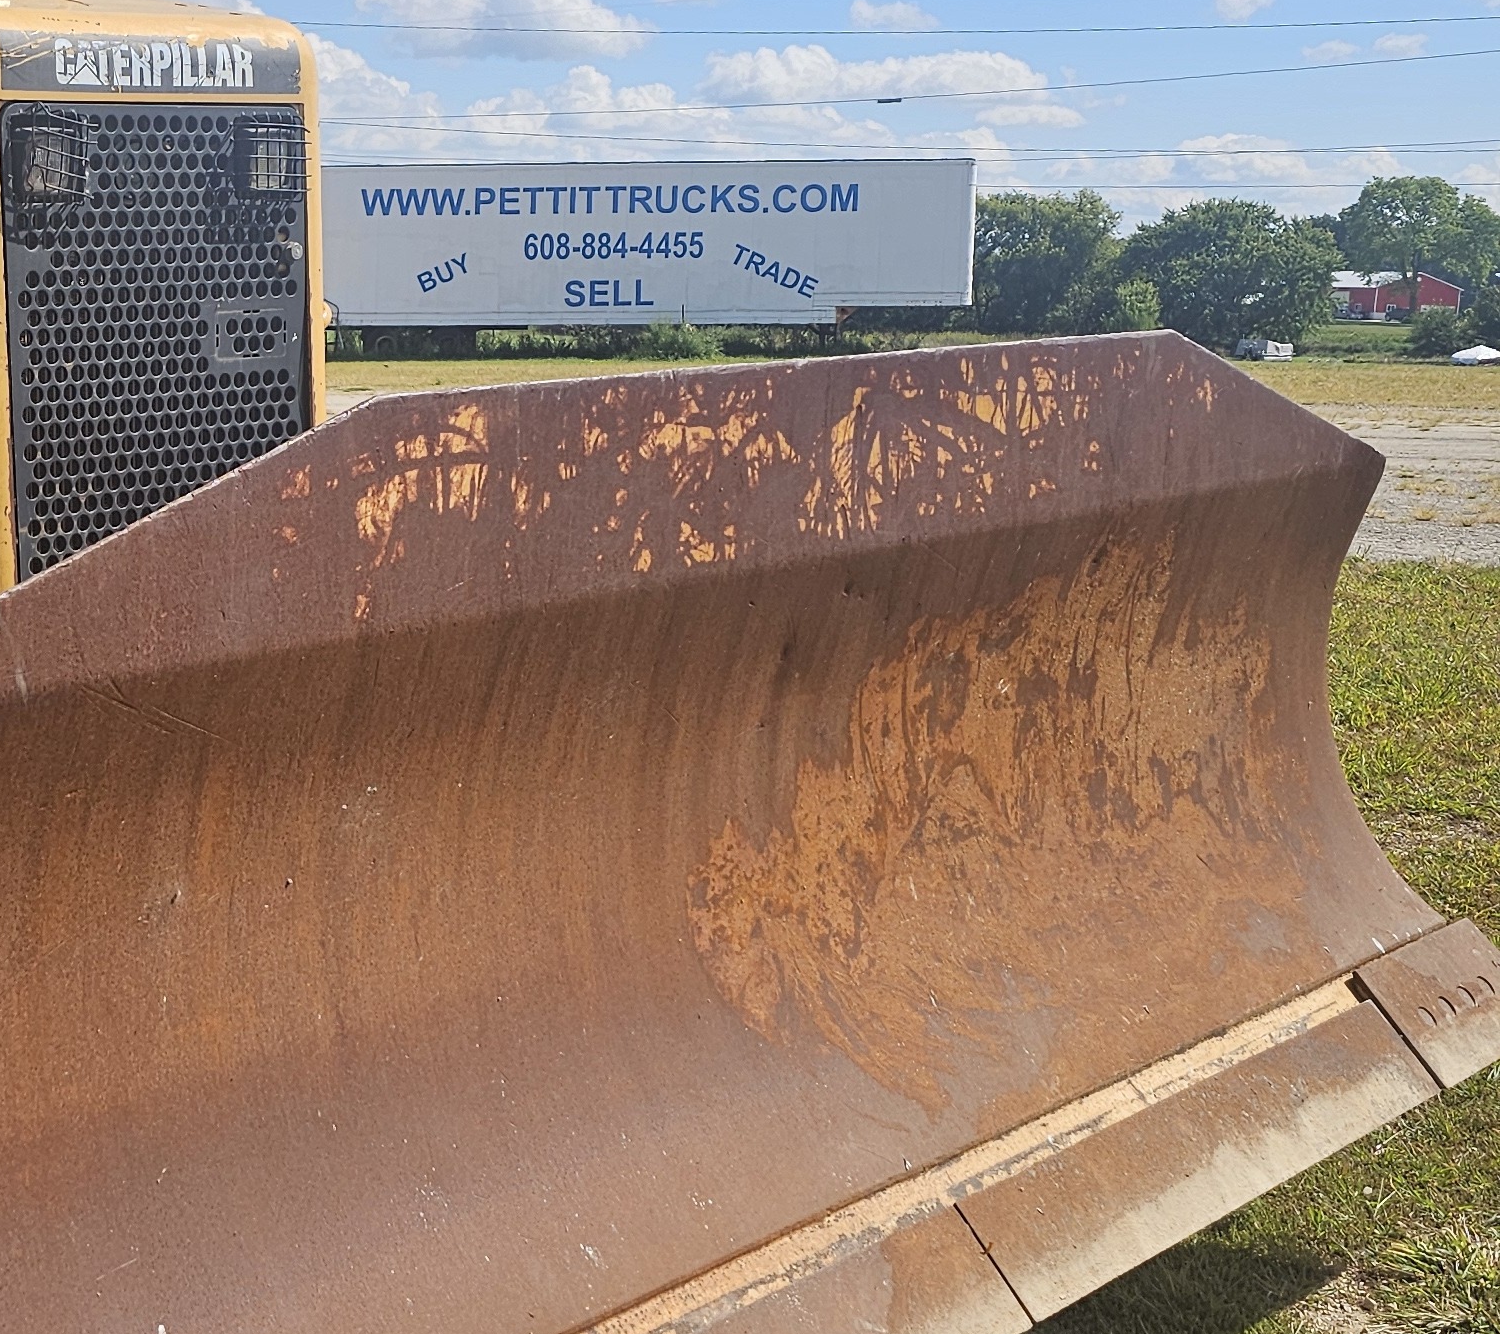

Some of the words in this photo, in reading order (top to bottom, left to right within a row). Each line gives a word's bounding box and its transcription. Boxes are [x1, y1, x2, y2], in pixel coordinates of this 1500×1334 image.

[54, 37, 254, 88] CATERPILLAR
[360, 183, 859, 216] WWW.PETTITTRUCKS.COM
[523, 231, 705, 261] 608-884-4455
[416, 252, 469, 293] BUY
[732, 243, 820, 299] TRADE
[563, 278, 655, 308] SELL
